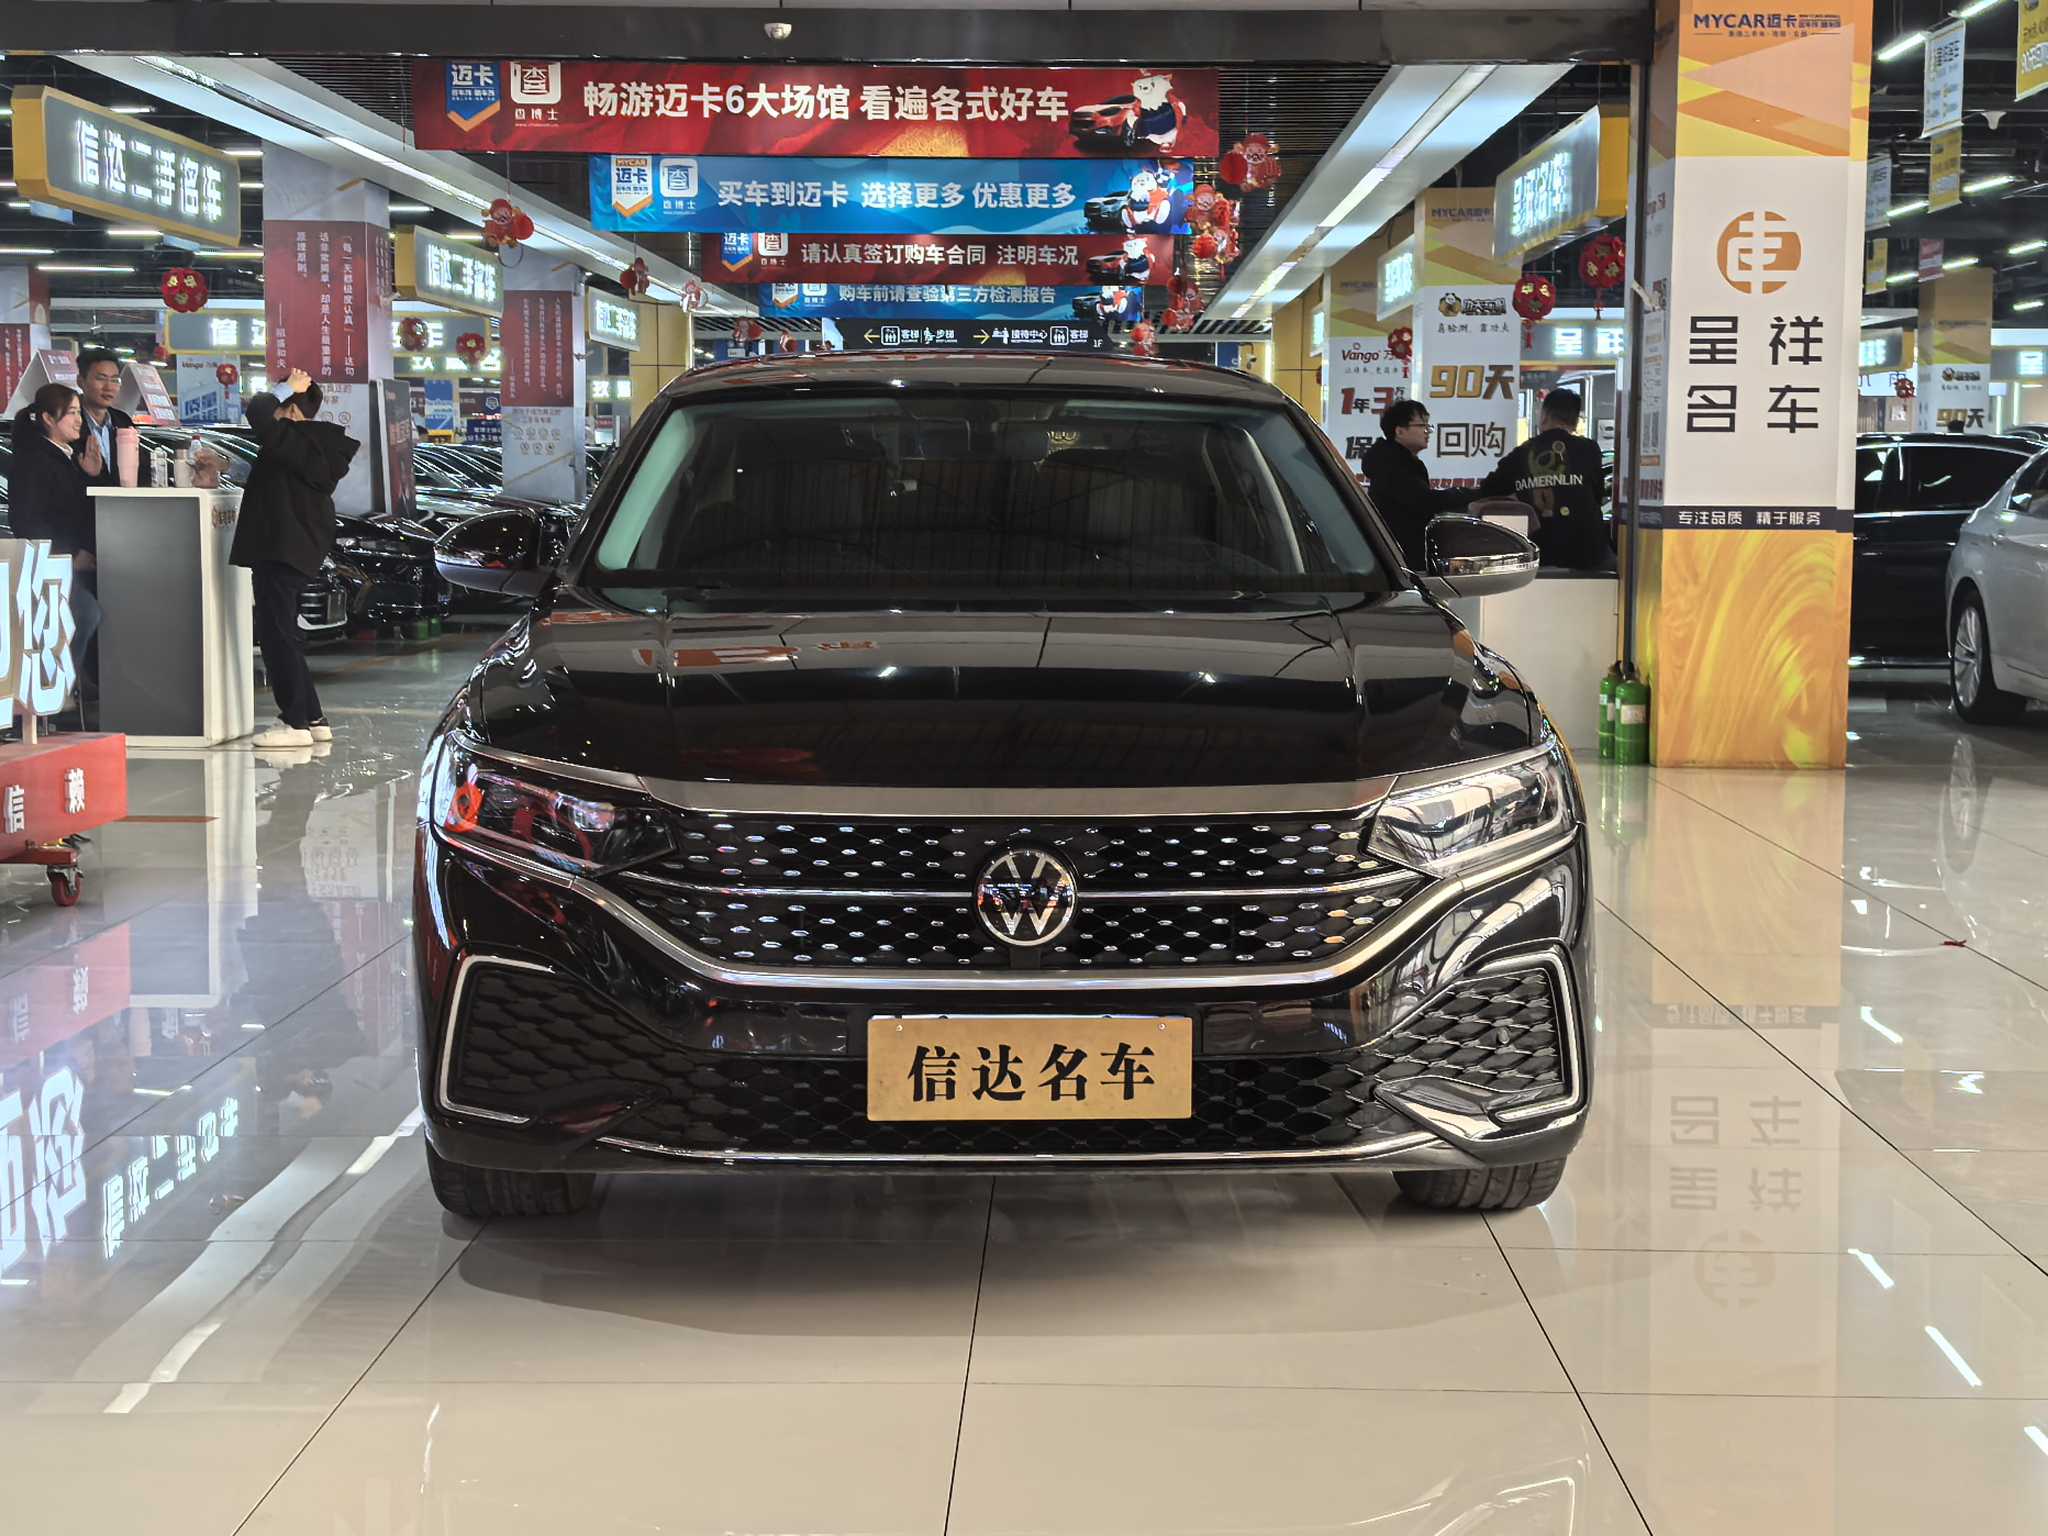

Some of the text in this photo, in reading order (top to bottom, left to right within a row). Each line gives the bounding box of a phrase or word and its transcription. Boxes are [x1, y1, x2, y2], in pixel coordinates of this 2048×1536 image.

[451, 64, 494, 86] 迈卡
[583, 81, 1070, 122] 畅游迈卡6大场馆 看遍各式好车
[76, 118, 224, 222] 信达二手名车
[616, 168, 648, 183] 迈卡
[718, 181, 1077, 209] 买车到迈卡 选择更多 优惠更多
[801, 243, 1079, 265] 请认真签订购车合同 注明车况
[1689, 316, 1823, 365] 呈祥
[1430, 364, 1515, 400] 90天
[1687, 385, 1821, 433] 名车
[1436, 421, 1507, 458] 回购
[1678, 511, 1821, 526] 专注品质 精于服务
[907, 1042, 1155, 1102] 信达名车
